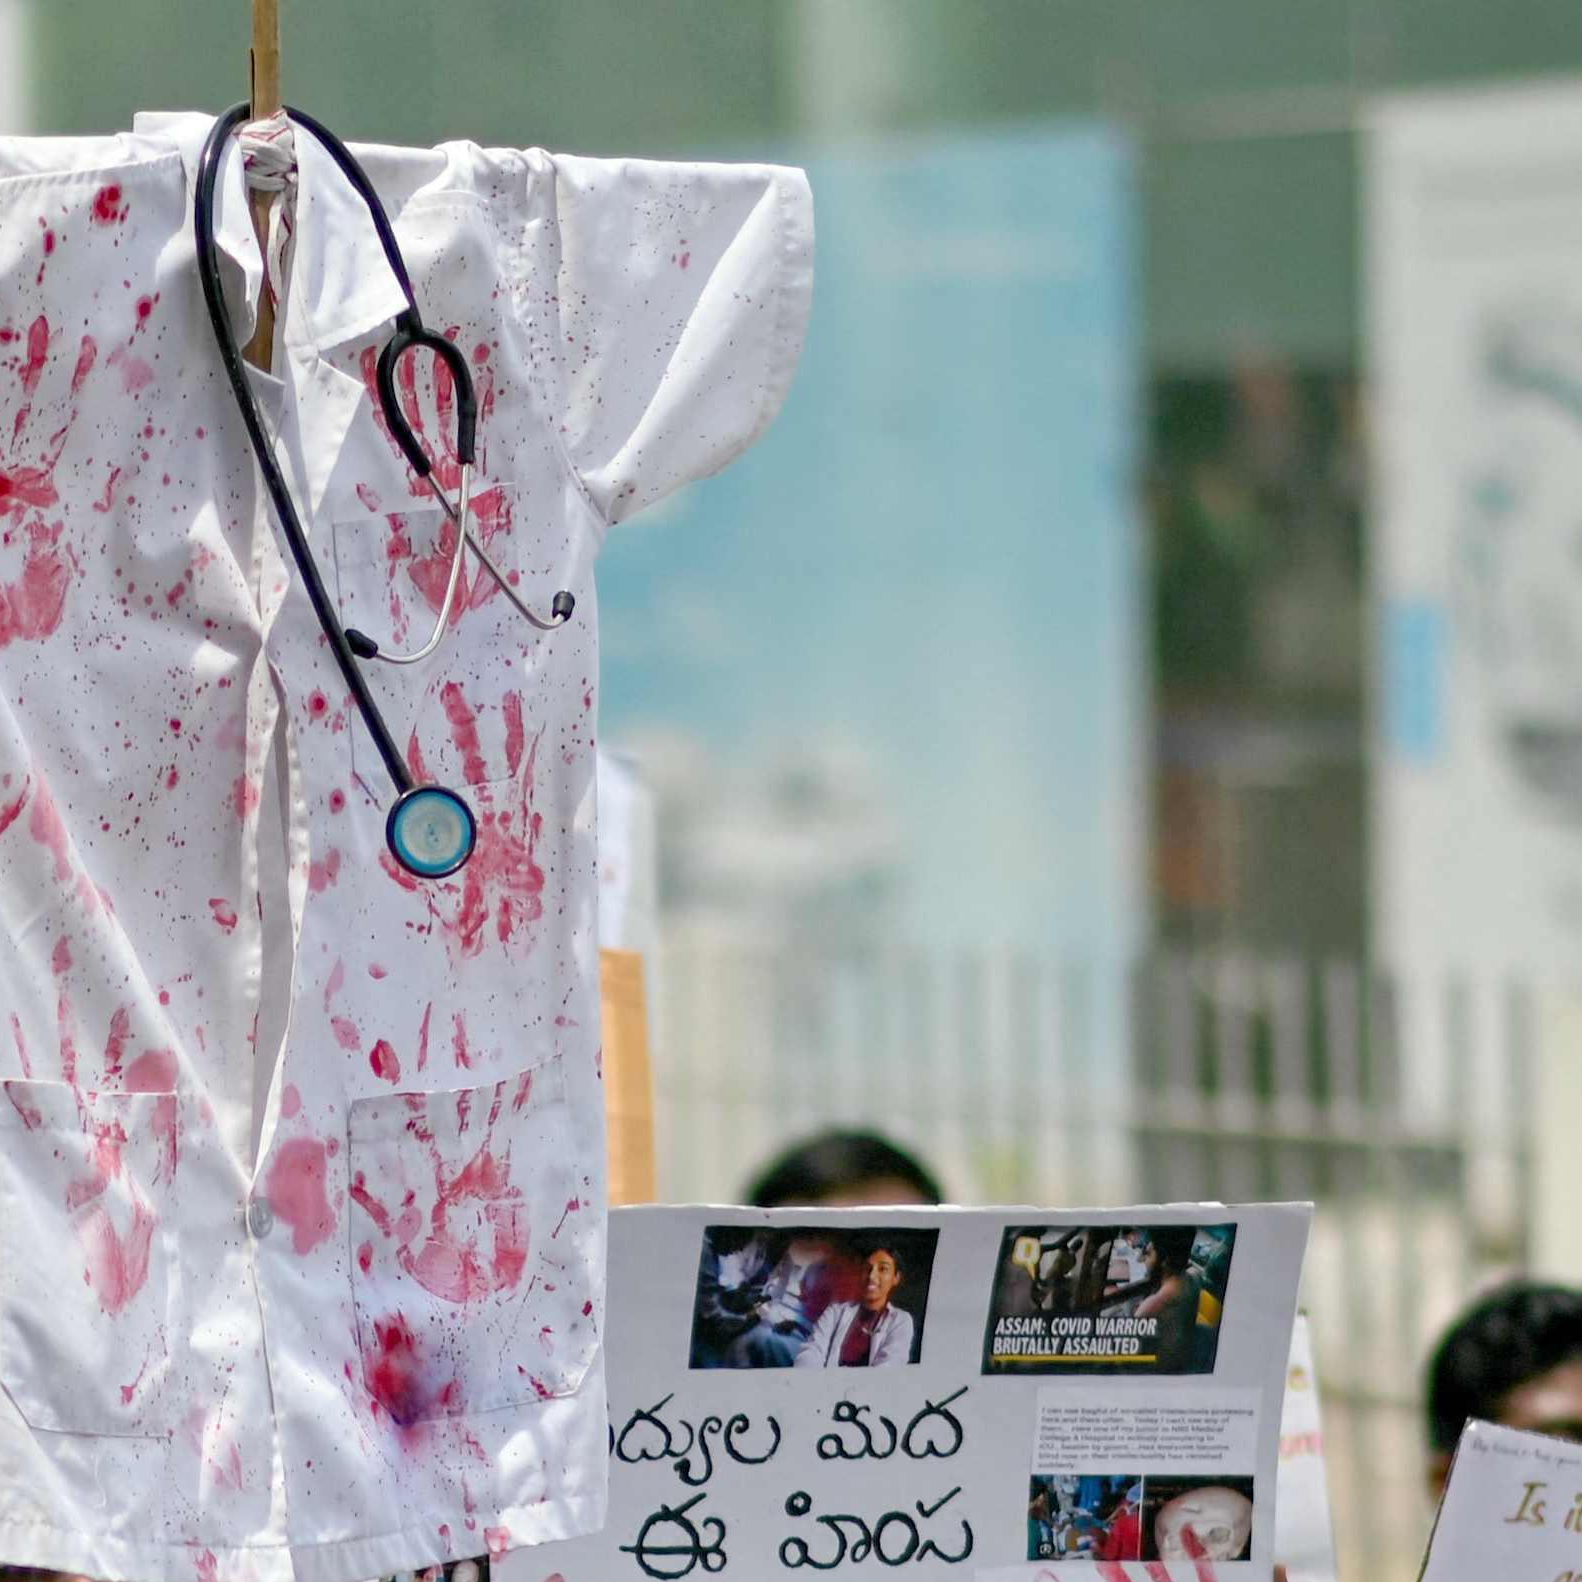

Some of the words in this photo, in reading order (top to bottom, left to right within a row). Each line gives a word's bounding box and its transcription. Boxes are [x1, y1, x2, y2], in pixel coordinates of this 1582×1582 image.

[995, 1317, 1047, 1336] ASSAM:
[1050, 1317, 1091, 1336] COVID
[1095, 1317, 1157, 1336] WARRIOR
[993, 1337, 1061, 1355] BRUTALLY
[1062, 1336, 1139, 1355] ASSAULTED
[609, 1392, 782, 1486] ద్యుల
[1503, 1481, 1548, 1527] Is
